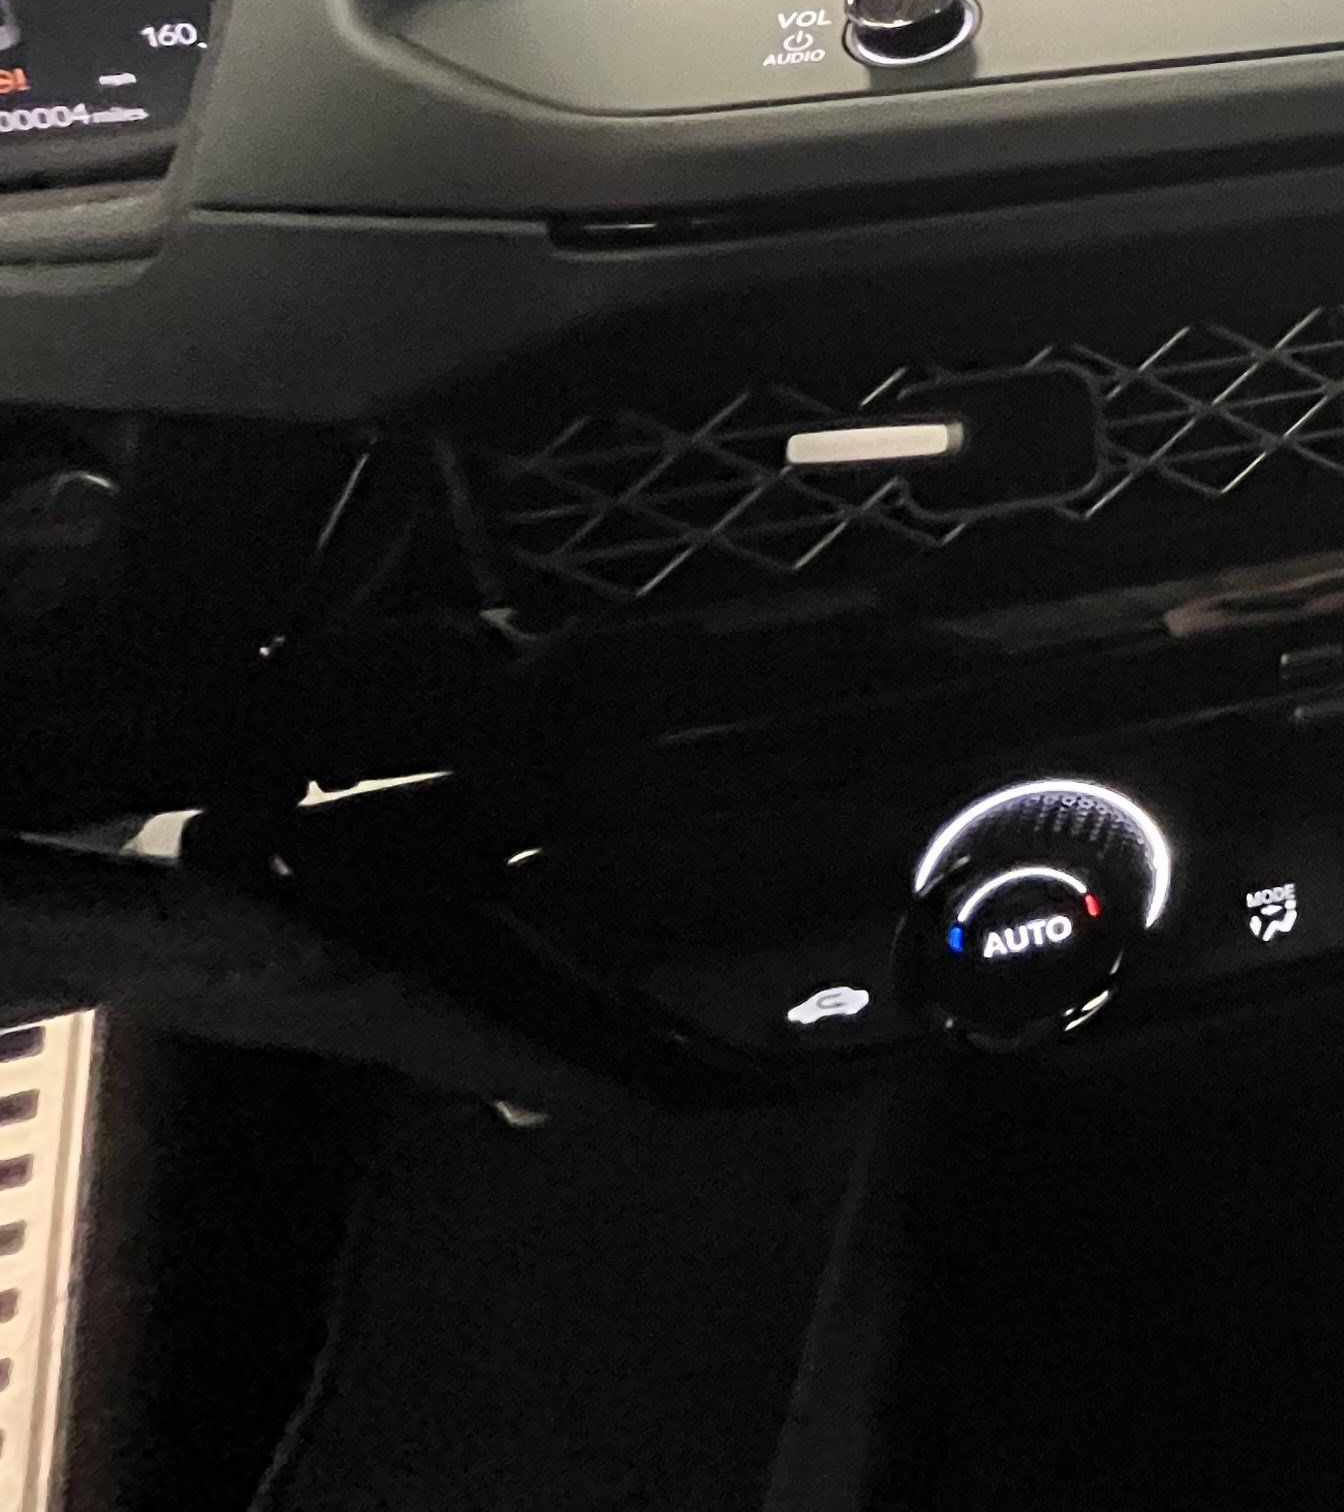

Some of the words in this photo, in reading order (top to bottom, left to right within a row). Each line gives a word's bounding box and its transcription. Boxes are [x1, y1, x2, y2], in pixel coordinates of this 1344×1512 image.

[777, 9, 832, 29] VOL
[140, 22, 198, 49] 160
[762, 49, 826, 67] AUDIO
[1245, 883, 1296, 908] MODE
[982, 915, 1074, 959] AUTO
